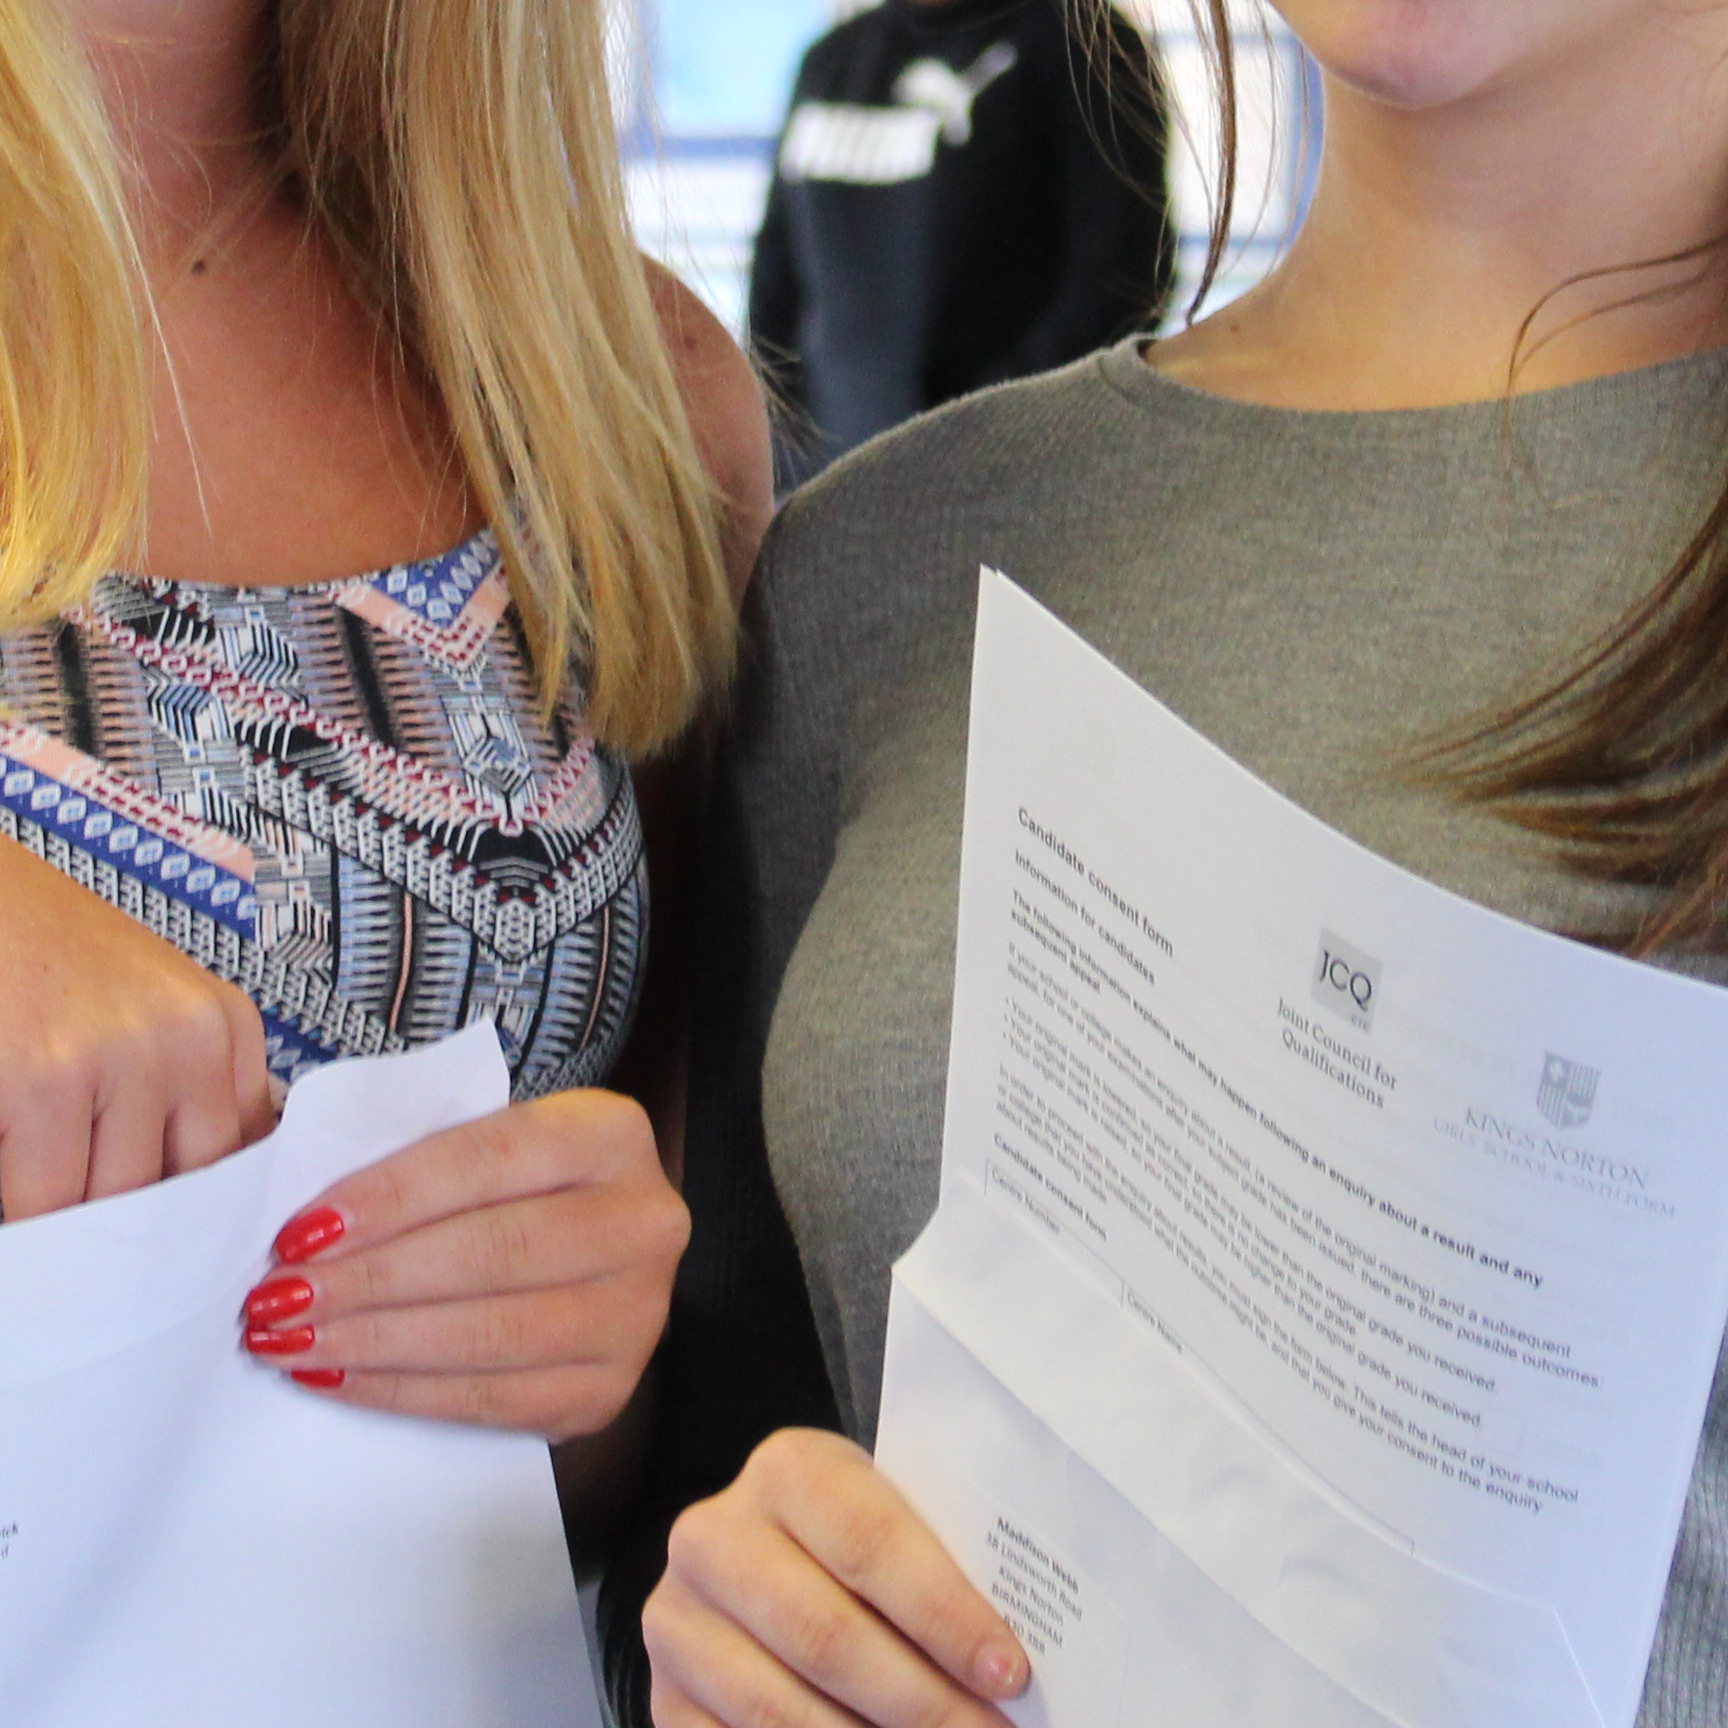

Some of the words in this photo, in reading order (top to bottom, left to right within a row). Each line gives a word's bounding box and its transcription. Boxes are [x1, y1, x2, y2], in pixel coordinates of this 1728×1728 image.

[1015, 847, 1078, 914] Information
[1080, 905, 1095, 928] for
[1098, 926, 1155, 985] candidates
[1018, 806, 1084, 875] Candidate
[1088, 872, 1139, 924] consent
[1142, 916, 1173, 956] form
[1319, 950, 1372, 1012] JCQ
[1013, 889, 1031, 913] The
[1033, 905, 1076, 957] following
[1078, 945, 1131, 1004] information
[1132, 999, 1170, 1041] explains
[1173, 1037, 1196, 1064] what
[1198, 1061, 1217, 1086] may
[1220, 1078, 1257, 1119] happen
[1259, 1111, 1308, 1163] following
[1311, 1155, 1326, 1172] an
[1329, 1168, 1376, 1209] enquiry
[1379, 1201, 1417, 1230] about
[1420, 1225, 1429, 1237] a
[1432, 1231, 1475, 1258] result
[1479, 1253, 1510, 1273] and
[1513, 1268, 1544, 1289] any
[1278, 996, 1309, 1035] Joint
[1312, 1025, 1371, 1076] Council
[1374, 1064, 1398, 1091] for
[1282, 1028, 1384, 1109] Qualifications
[994, 1129, 1043, 1184] Candidate
[1045, 1178, 1083, 1218] consent
[1085, 1212, 1106, 1239] form
[1465, 1106, 1536, 1150] KINGS
[1542, 1138, 1650, 1190] NORTON
[1230, 1242, 1242, 1260] be
[1243, 1254, 1272, 1289] higher
[1274, 1282, 1296, 1310] than
[1298, 1302, 1314, 1324] the
[1315, 1319, 1356, 1357] original
[1358, 1351, 1391, 1380] grade
[1395, 1376, 1418, 1396] you
[1236, 1231, 1249, 1248] no
[1250, 1244, 1285, 1281] change
[1287, 1273, 1297, 1291] to
[1299, 1287, 1321, 1311] your
[1241, 1177, 1267, 1207] grade
[1269, 1200, 1287, 1223] has
[1290, 1217, 1316, 1246] been
[1361, 1268, 1391, 1297] there
[1394, 1293, 1415, 1311] are
[1419, 1304, 1453, 1331] three
[1456, 1326, 1518, 1360] possible
[1241, 1213, 1252, 1232] be
[1255, 1226, 1280, 1257] lower
[1281, 1249, 1303, 1276] than
[1306, 1269, 1323, 1292] the
[1324, 1287, 1366, 1323] original
[1368, 1318, 1403, 1346] grade
[1407, 1342, 1431, 1362] you
[1254, 1167, 1265, 1185] (a
[1267, 1181, 1299, 1213] review
[1302, 1208, 1313, 1223] of
[1314, 1215, 1332, 1237] the
[1334, 1233, 1377, 1268] original
[1379, 1262, 1435, 1304] marking)
[1438, 1296, 1465, 1316] and
[1468, 1311, 1478, 1322] a
[1481, 1317, 1571, 1356] subsequent
[1229, 1282, 1251, 1308] must
[1252, 1305, 1271, 1328] sign
[1273, 1320, 1288, 1342] the
[1290, 1336, 1313, 1363] form
[1354, 1385, 1376, 1410] This
[1380, 1404, 1404, 1428] tells
[1407, 1420, 1428, 1441] the
[1432, 1435, 1467, 1461] head
[1470, 1455, 1485, 1469] of
[1488, 1464, 1520, 1484] your
[1527, 1479, 1579, 1501] school
[1271, 1342, 1289, 1363] and
[1291, 1356, 1310, 1381] that
[1312, 1378, 1331, 1399] you
[1333, 1395, 1356, 1418] give
[1359, 1414, 1384, 1437] your
[1387, 1432, 1437, 1467] consent
[1441, 1460, 1454, 1476] to
[1458, 1468, 1480, 1488] the
[1486, 1483, 1543, 1514] enquiry
[997, 1516, 1049, 1567] Maddison
[991, 1582, 1063, 1648] BIRMINGHAM
[1030, 1587, 1064, 1626] Norton
